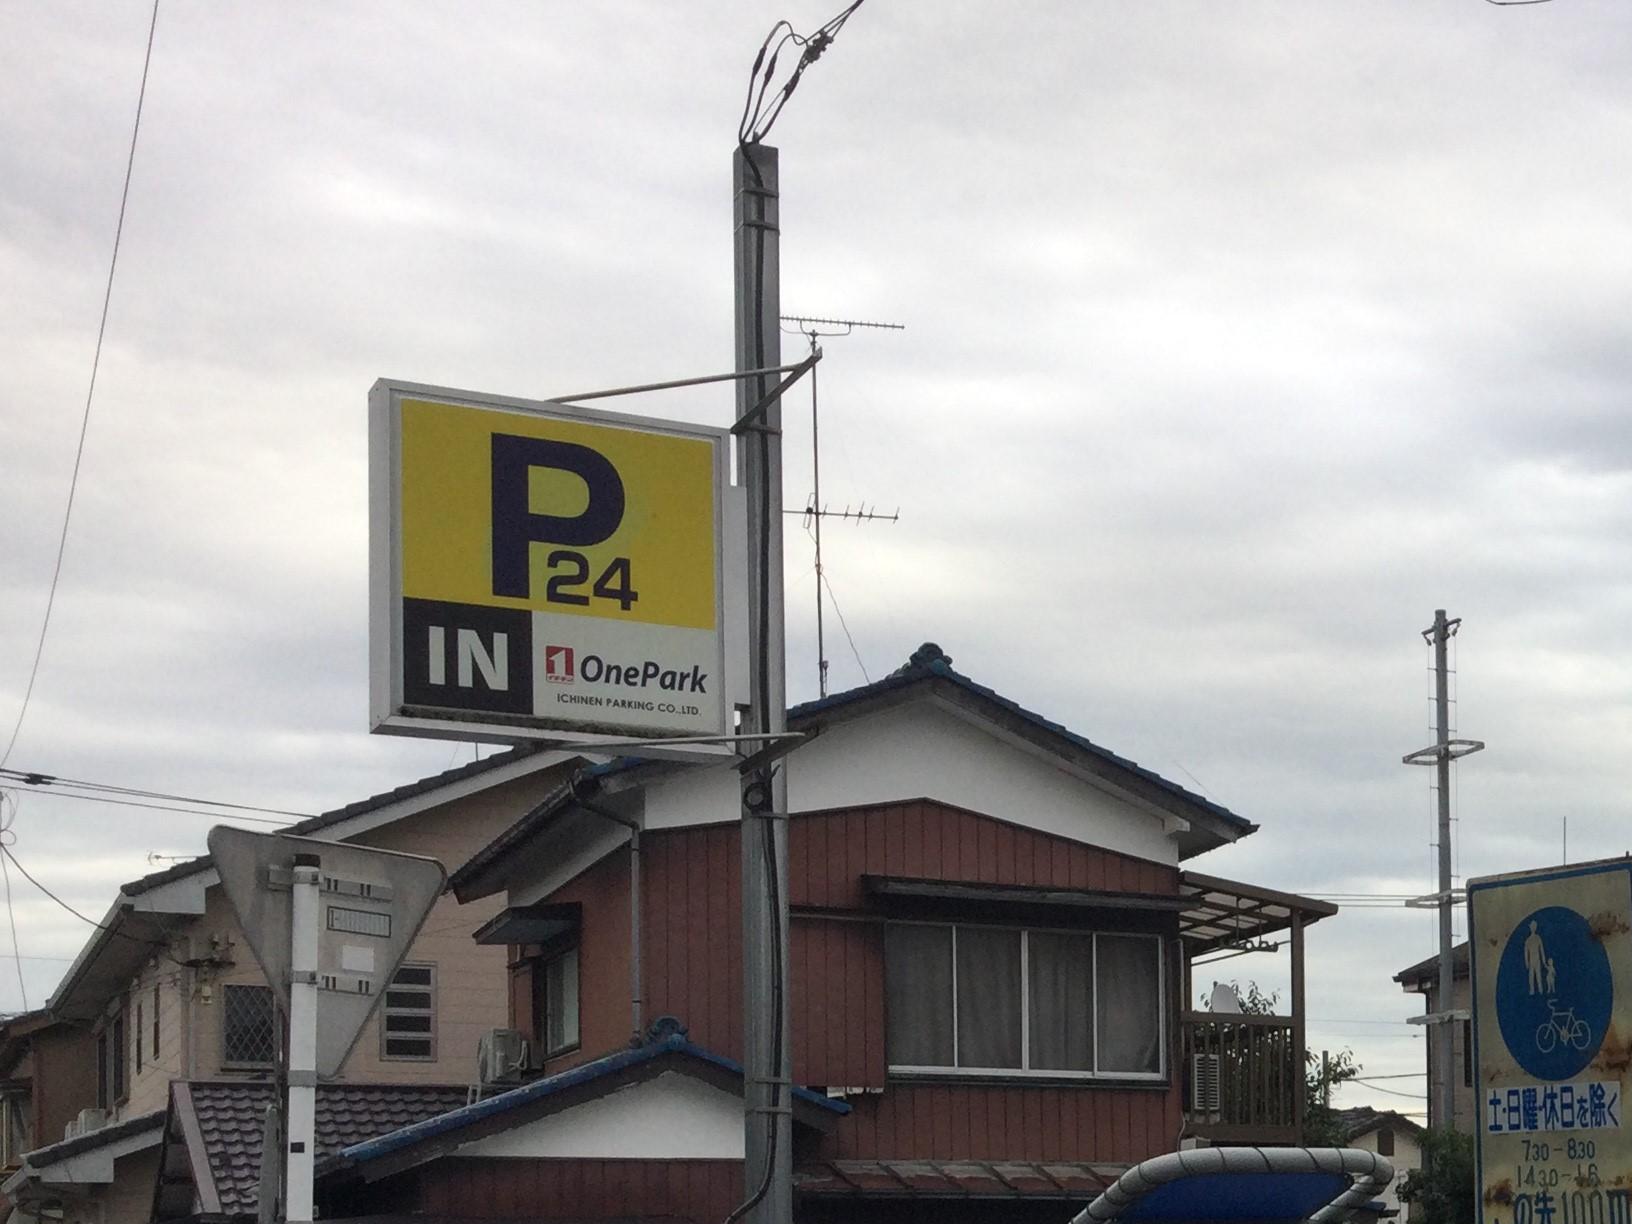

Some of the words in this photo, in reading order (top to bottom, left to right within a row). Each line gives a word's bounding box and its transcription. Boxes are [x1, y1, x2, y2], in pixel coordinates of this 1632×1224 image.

[491, 432, 625, 599] P
[546, 550, 639, 611] 24
[428, 625, 509, 691] IN
[580, 654, 707, 694] OnePark
[557, 693, 603, 706] ICHINEN
[606, 698, 654, 712] PARKING
